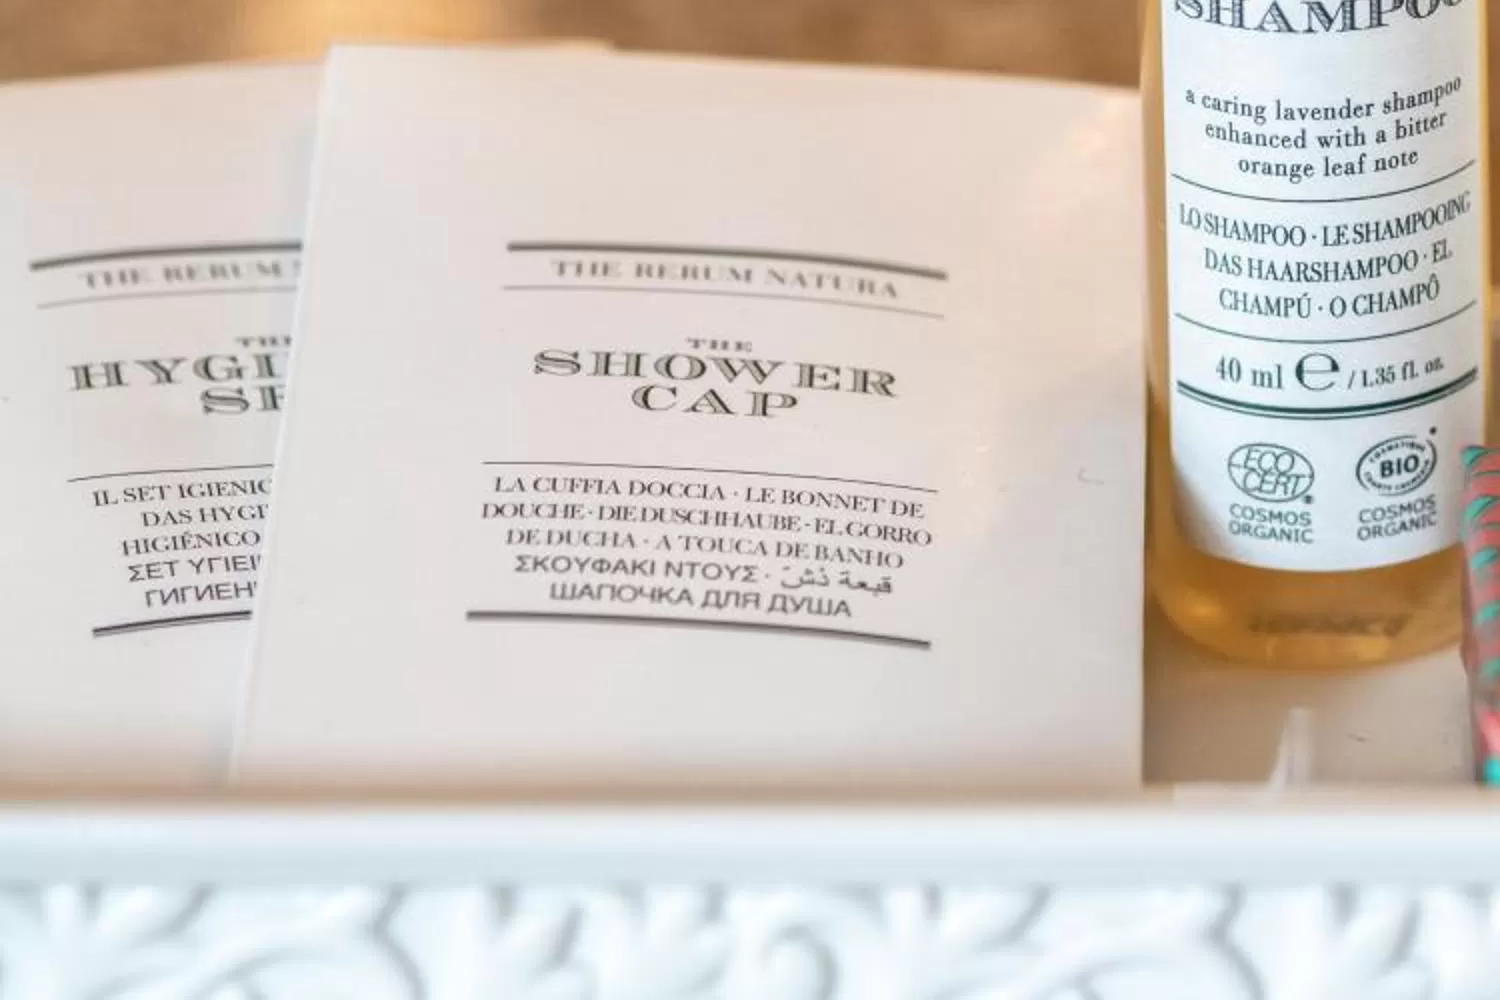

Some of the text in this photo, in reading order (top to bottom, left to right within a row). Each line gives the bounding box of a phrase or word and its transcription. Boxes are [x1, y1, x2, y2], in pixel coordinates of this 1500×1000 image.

[1186, 77, 1461, 125] a caring lavender shampoo
[1206, 113, 1447, 149] enhanced with a bitter
[1239, 151, 1419, 183] orange leaf note
[1179, 191, 1470, 247] LO SHAMPOO LE SHAMPOOING
[1205, 239, 1452, 283] DAS HAARSHAMPOO EL
[550, 259, 898, 298] THE RERUM NATURA
[1219, 273, 1439, 318] CHAMPÚ O CHAMPÔ
[686, 337, 752, 351] THE
[67, 353, 288, 391] HYGI
[533, 349, 899, 397] SHOWER
[1216, 356, 1396, 389] 40 ml 1.35
[632, 385, 798, 417] CAP
[1380, 454, 1420, 479] BIO
[93, 479, 272, 506] IL SET IGIENIC
[495, 477, 924, 518] LA CUFFIA DOCCIA LE BONNET DE
[141, 510, 192, 527] DAS
[482, 503, 933, 547] DOUCHE DIE DUSCHHAUBE GORRO
[1229, 503, 1312, 526] COSMOS
[1357, 511, 1438, 541] ORGANIC
[1359, 495, 1436, 524] COSMOS
[1228, 520, 1314, 544] ORGANIC
[507, 530, 903, 568] DE DUCHA TOUCA BANHO
[145, 582, 257, 608] ГИГИЕН
[550, 583, 852, 617] ШАПОЧКА ДЛЯ ДУША
